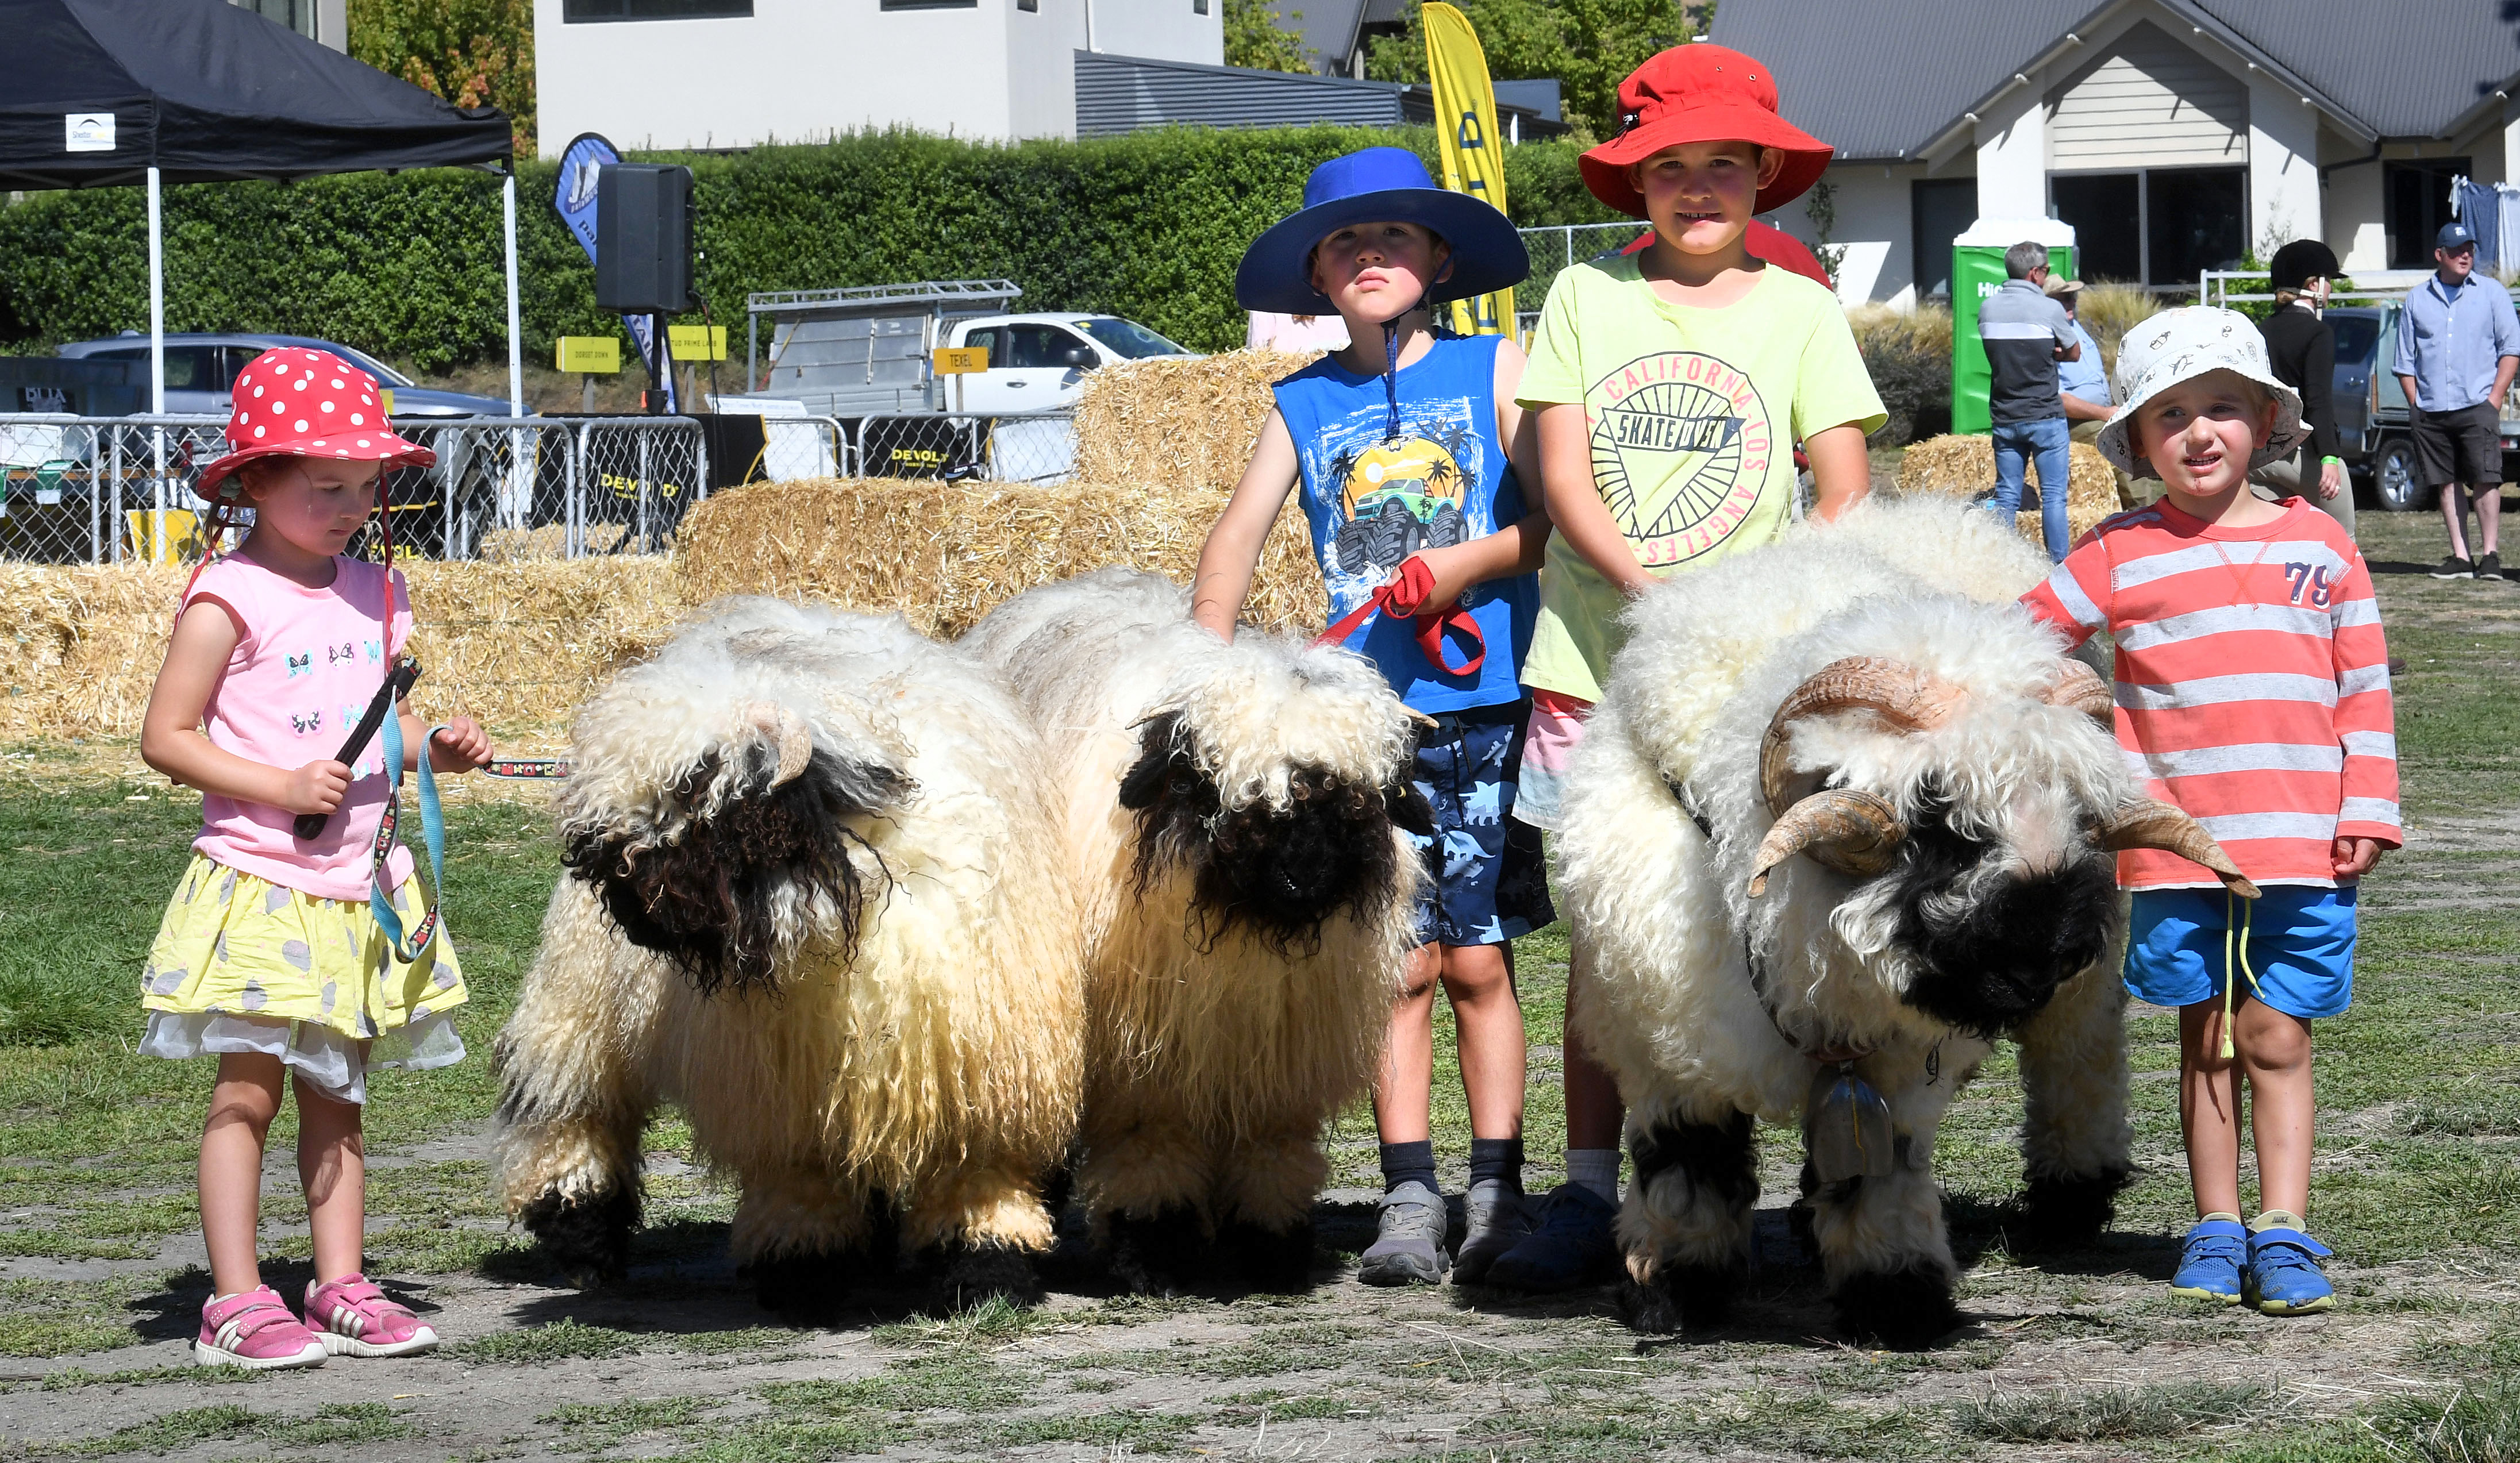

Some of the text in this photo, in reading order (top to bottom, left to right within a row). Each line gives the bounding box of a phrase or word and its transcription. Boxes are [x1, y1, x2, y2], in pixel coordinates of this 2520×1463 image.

[949, 353, 972, 367] TEXEL
[1604, 356, 1755, 411] CALIFORNIA
[1617, 414, 1676, 448] SKATE
[1744, 419, 1768, 472] LOS
[1646, 484, 1755, 564] ANGELES
[2285, 561, 2330, 610] 79
